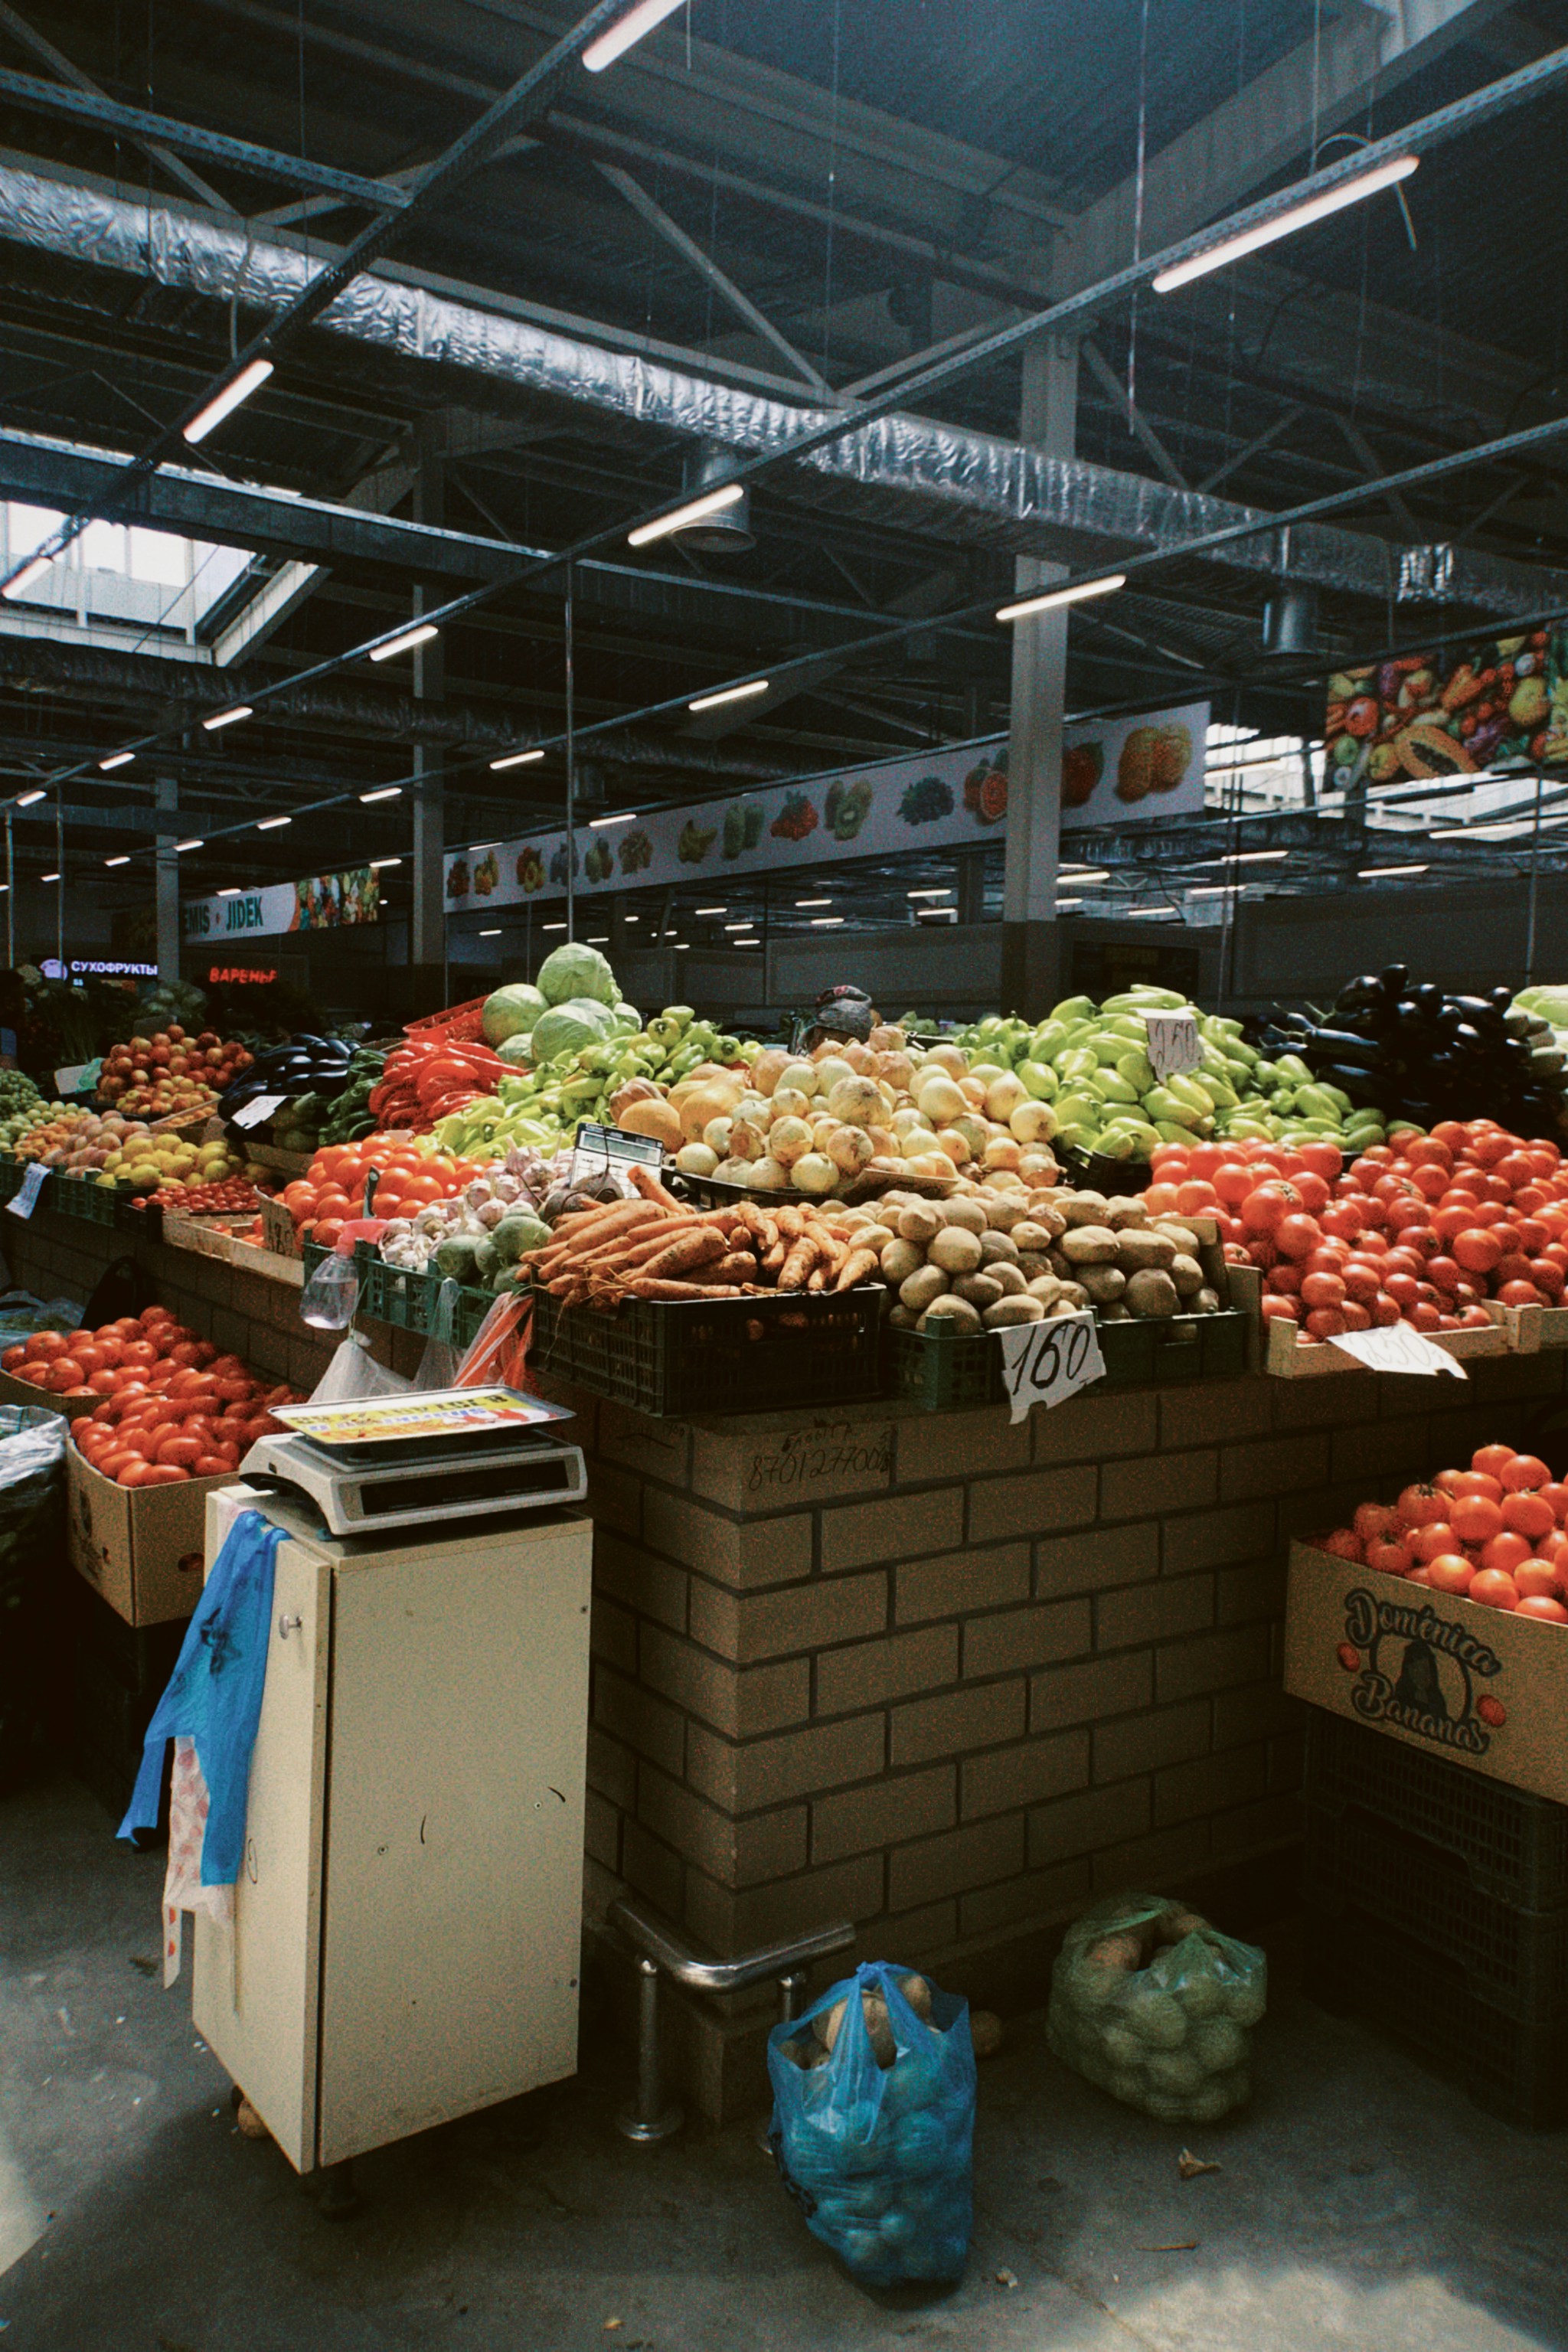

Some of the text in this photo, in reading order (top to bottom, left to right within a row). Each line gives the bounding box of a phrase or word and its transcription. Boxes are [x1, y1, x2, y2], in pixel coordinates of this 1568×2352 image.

[227, 897, 263, 931] JIDEK
[71, 961, 158, 975] СУХОФРУКТЫ
[1011, 1318, 1090, 1396] 160
[1345, 1588, 1501, 1677] Doménica
[1352, 1668, 1490, 1754] Bananas
